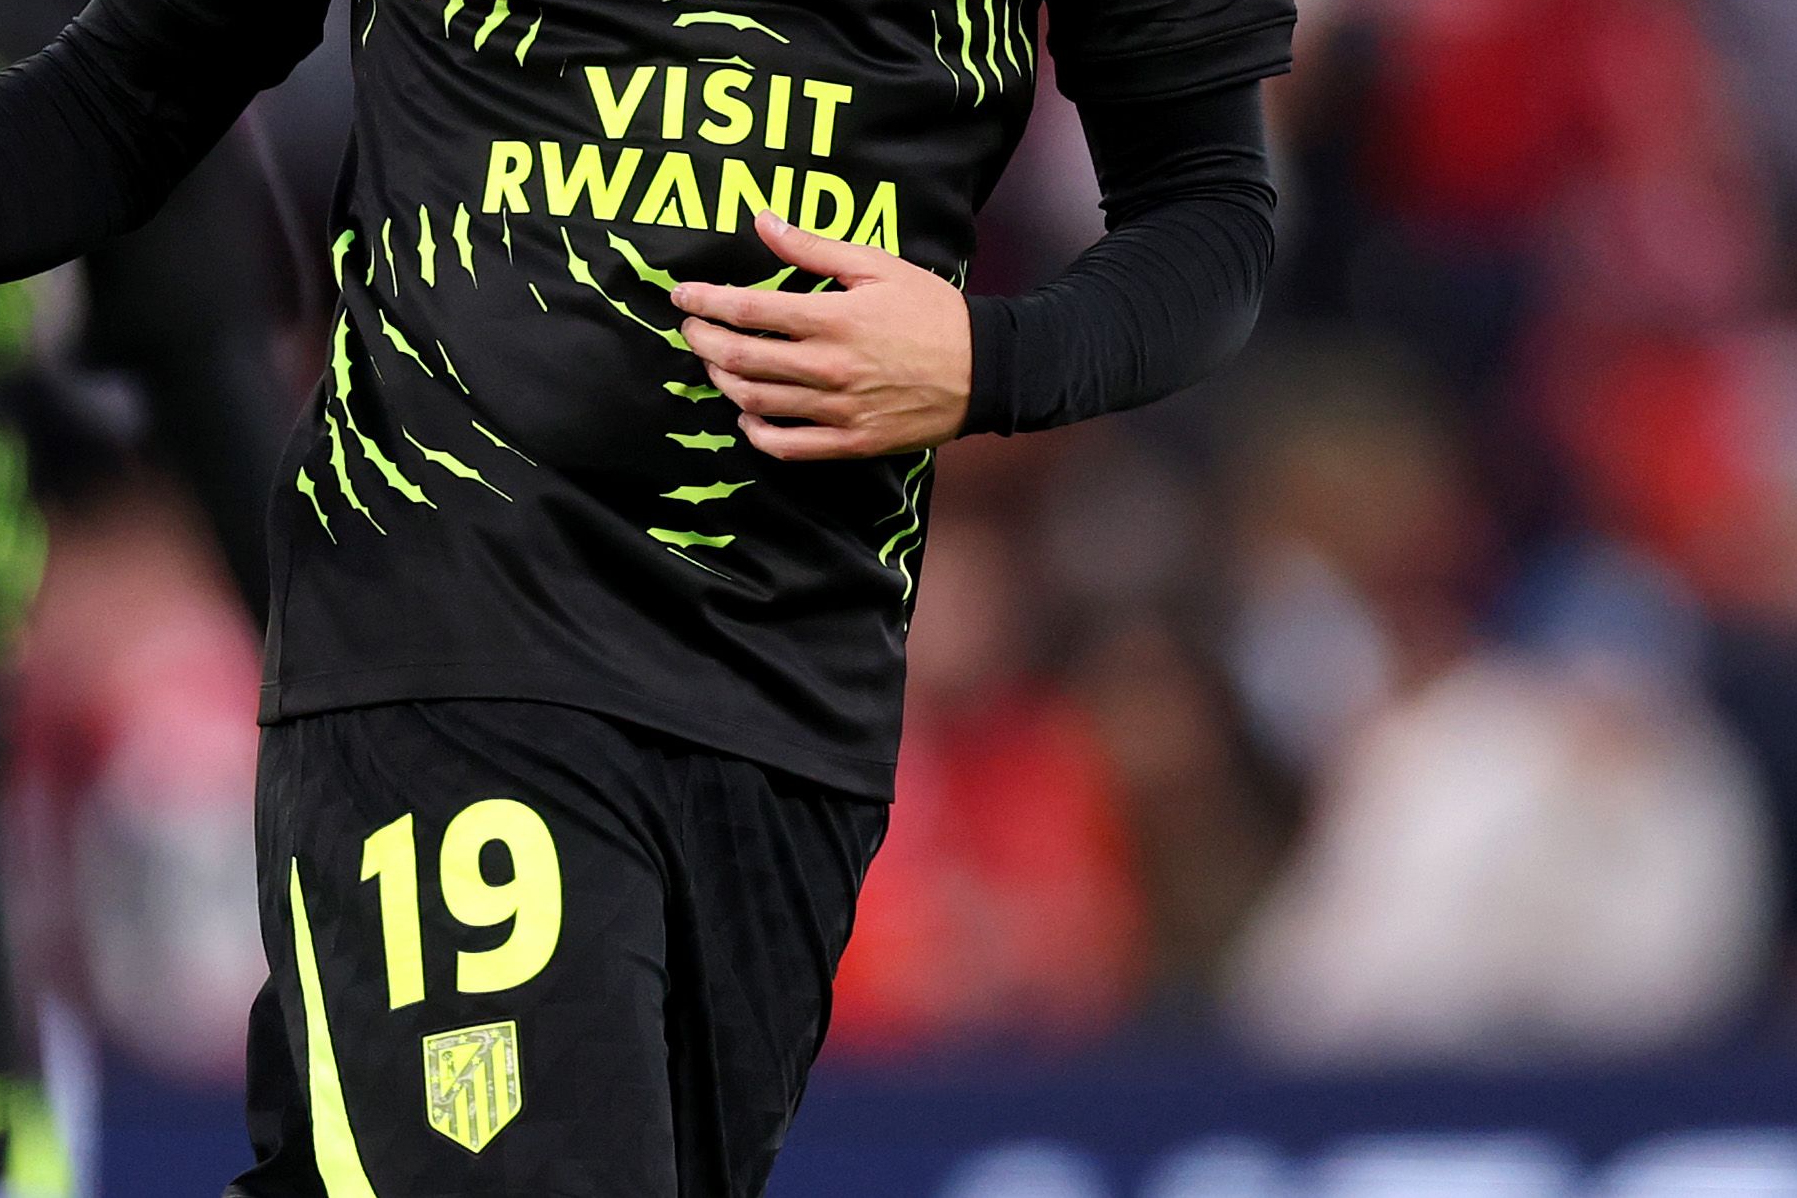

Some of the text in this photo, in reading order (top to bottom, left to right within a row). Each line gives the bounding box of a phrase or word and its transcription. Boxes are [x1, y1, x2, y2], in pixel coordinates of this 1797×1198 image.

[583, 65, 853, 158] VISIT
[481, 140, 902, 258] RWANDA
[359, 798, 563, 1011] 19
